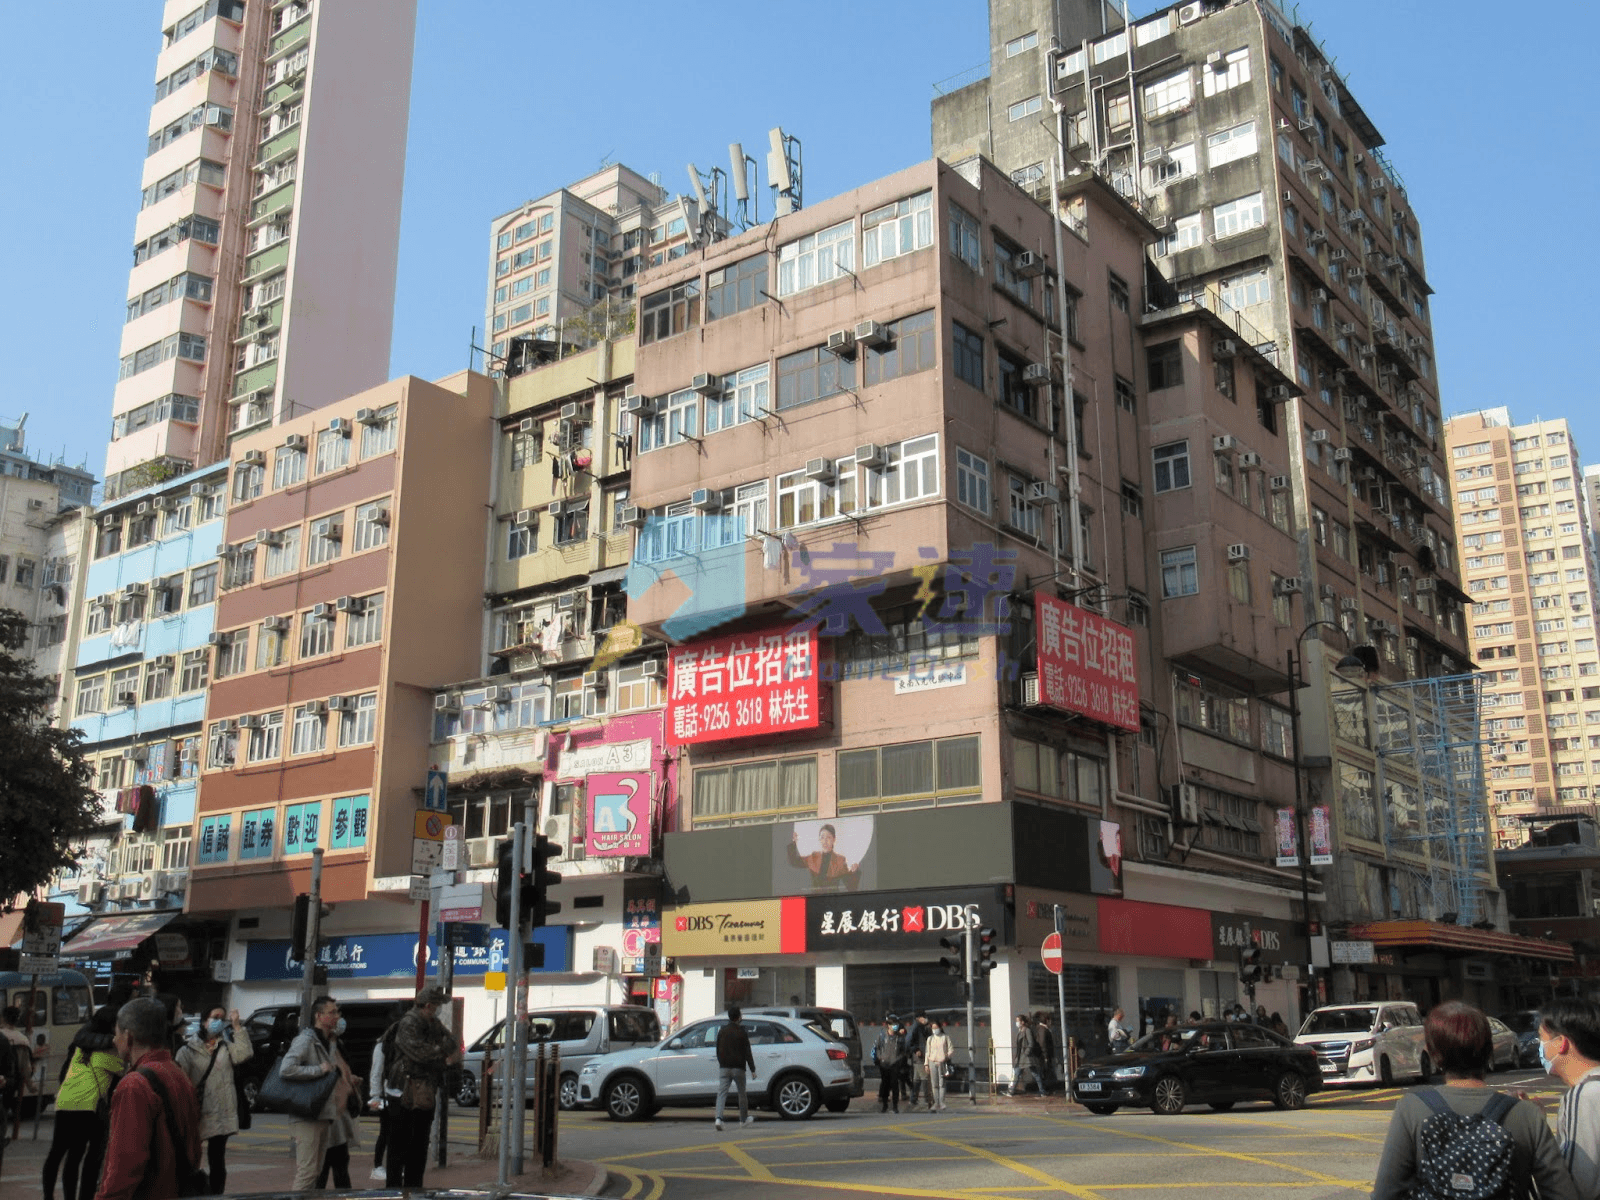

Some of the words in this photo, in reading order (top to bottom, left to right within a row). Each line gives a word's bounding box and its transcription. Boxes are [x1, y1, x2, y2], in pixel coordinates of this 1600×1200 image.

[1041, 601, 1136, 683] 廣告位招租
[672, 630, 812, 701] 廣告位招租
[735, 696, 763, 727] 3618
[768, 685, 810, 726] 林先生
[1089, 681, 1109, 715] 3618
[1111, 684, 1137, 726] 林先生
[620, 833, 642, 841] SALON
[687, 916, 713, 931] DBS
[715, 913, 764, 934] Treasures
[820, 908, 900, 935] 星展銀行
[926, 904, 981, 931] DBS
[1260, 930, 1280, 950] DBS
